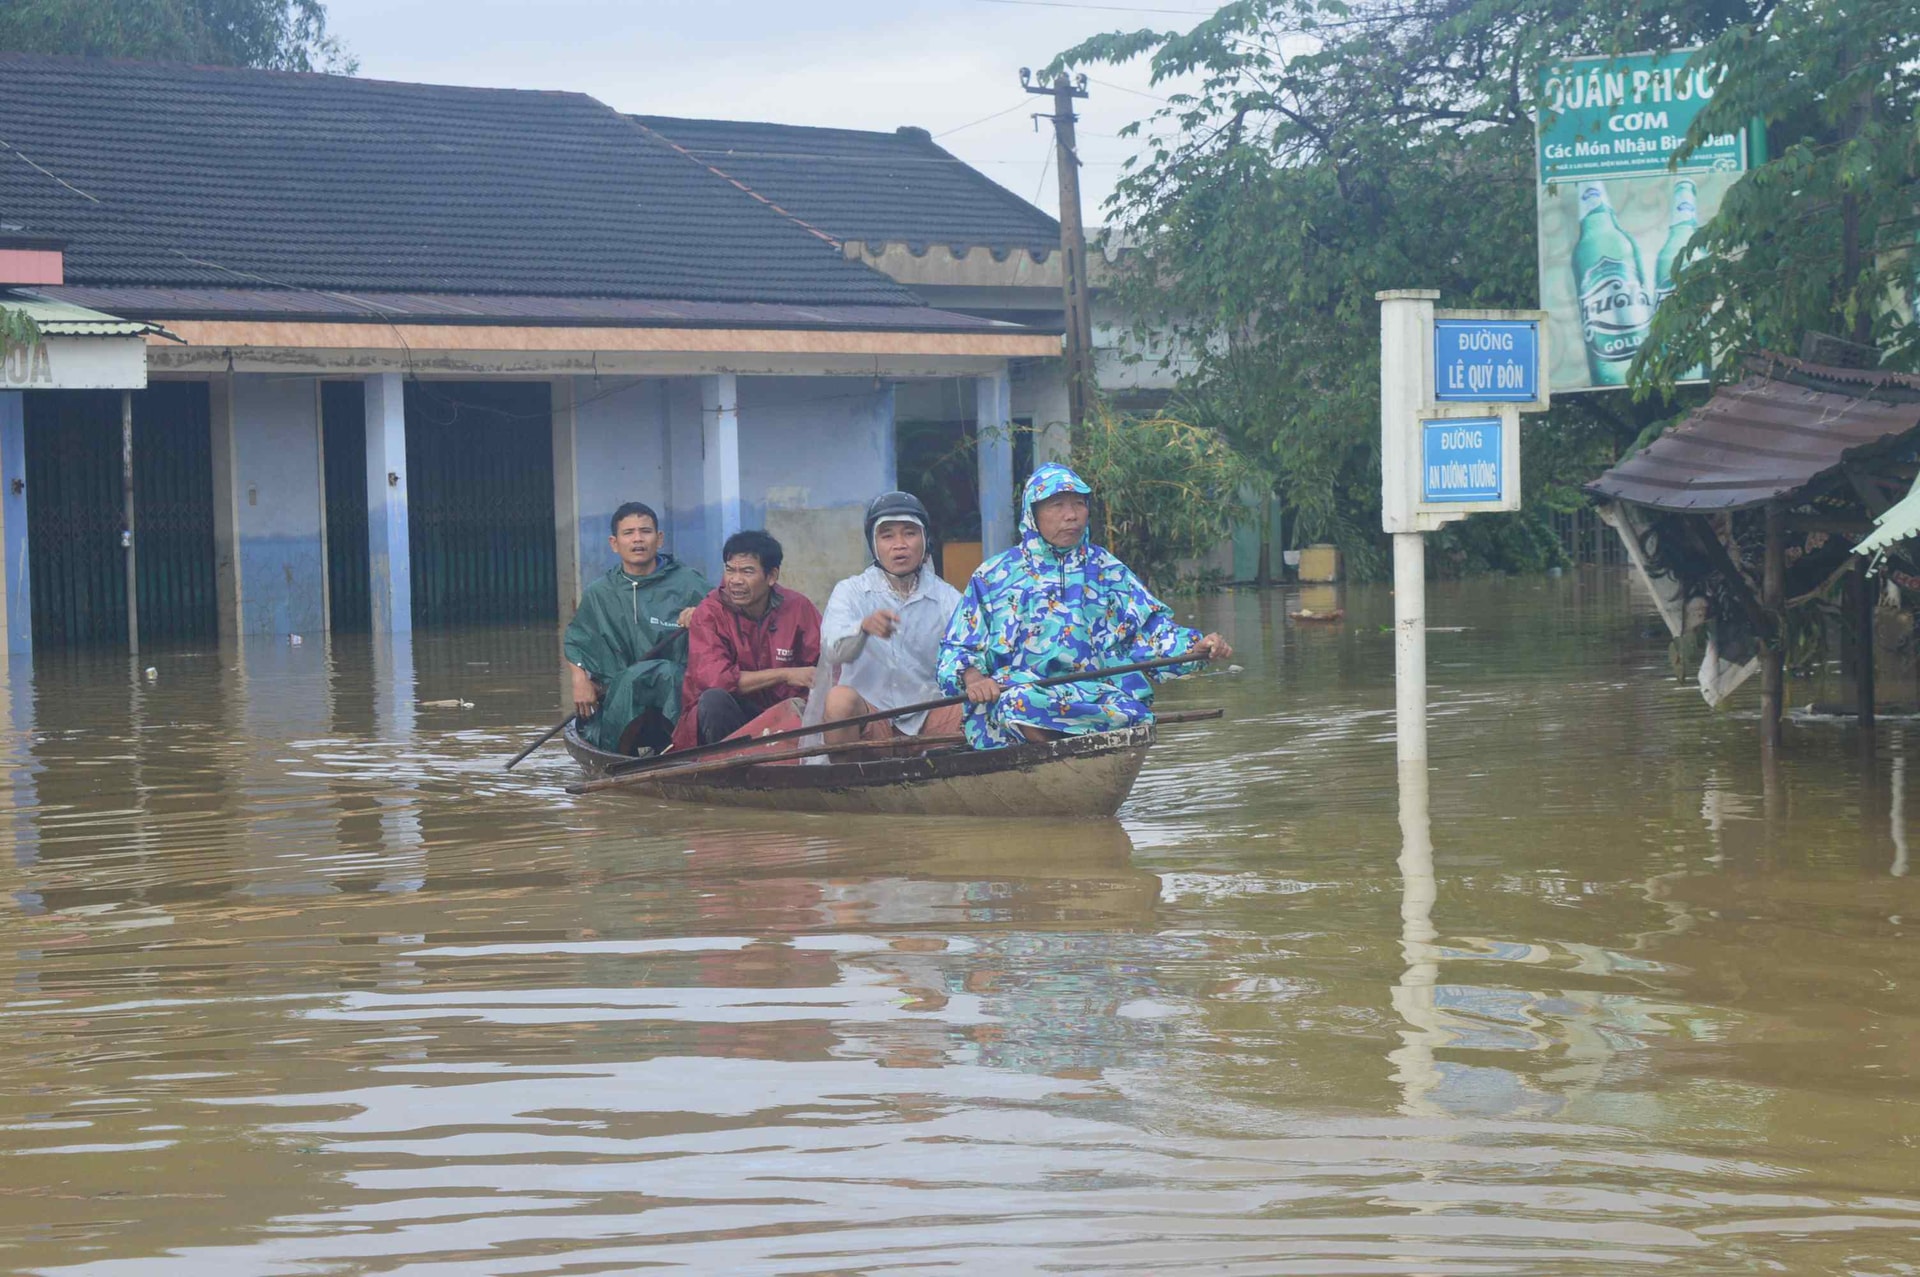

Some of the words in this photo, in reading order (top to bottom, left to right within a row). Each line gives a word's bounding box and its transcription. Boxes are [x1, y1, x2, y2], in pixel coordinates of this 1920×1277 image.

[1544, 67, 1625, 114] QUÁN
[1608, 111, 1669, 132] CƠM
[1544, 144, 1572, 159] Các
[1575, 141, 1610, 156] Món
[1614, 137, 1657, 156] Nhậu
[1459, 329, 1513, 351] ĐƯỜNG
[1604, 335, 1643, 353] GOLD
[1449, 358, 1464, 389] LÊ
[1468, 358, 1493, 393] QUÝ
[1497, 358, 1523, 389] ĐÔN
[1441, 427, 1482, 450] ĐƯỜNG
[1429, 465, 1440, 489] AN
[1441, 460, 1468, 489] DƯƠNG
[1469, 459, 1496, 488] VƯƠNG
